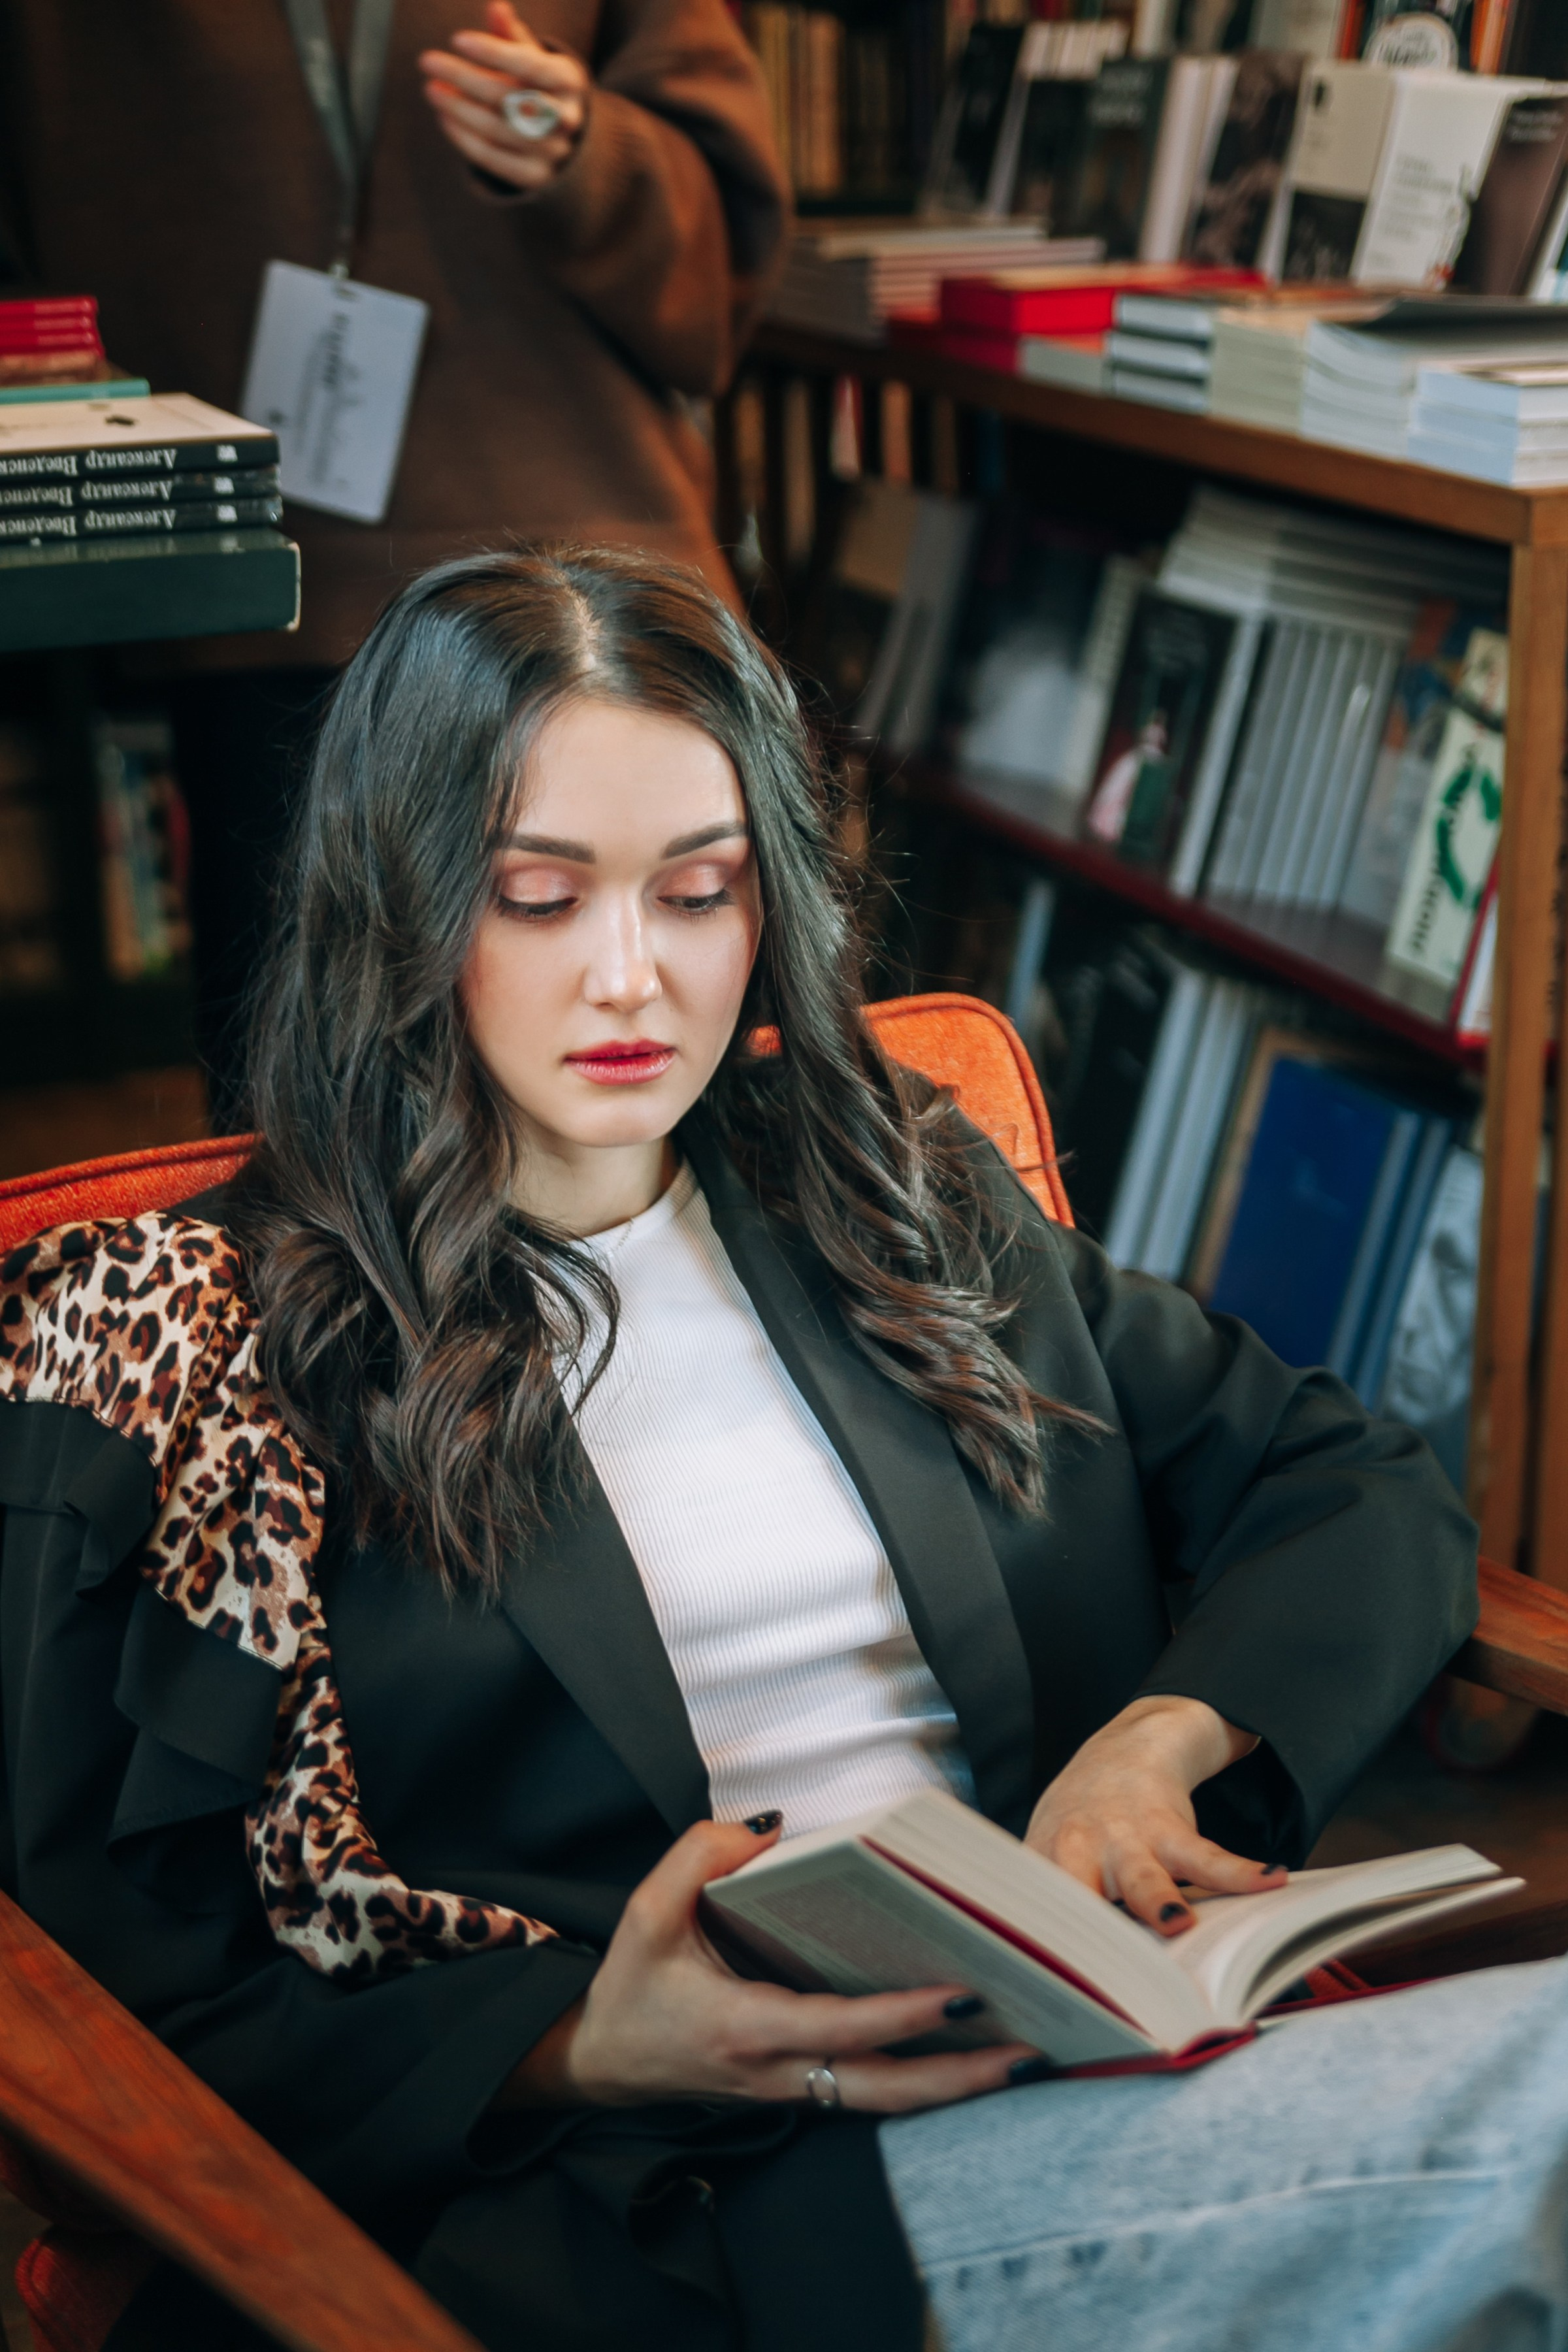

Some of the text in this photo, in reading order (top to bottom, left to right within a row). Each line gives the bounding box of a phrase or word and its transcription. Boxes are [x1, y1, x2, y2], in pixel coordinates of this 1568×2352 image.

[85, 448, 176, 469] Александр
[80, 480, 172, 500] Александр
[84, 509, 176, 530] Александр
